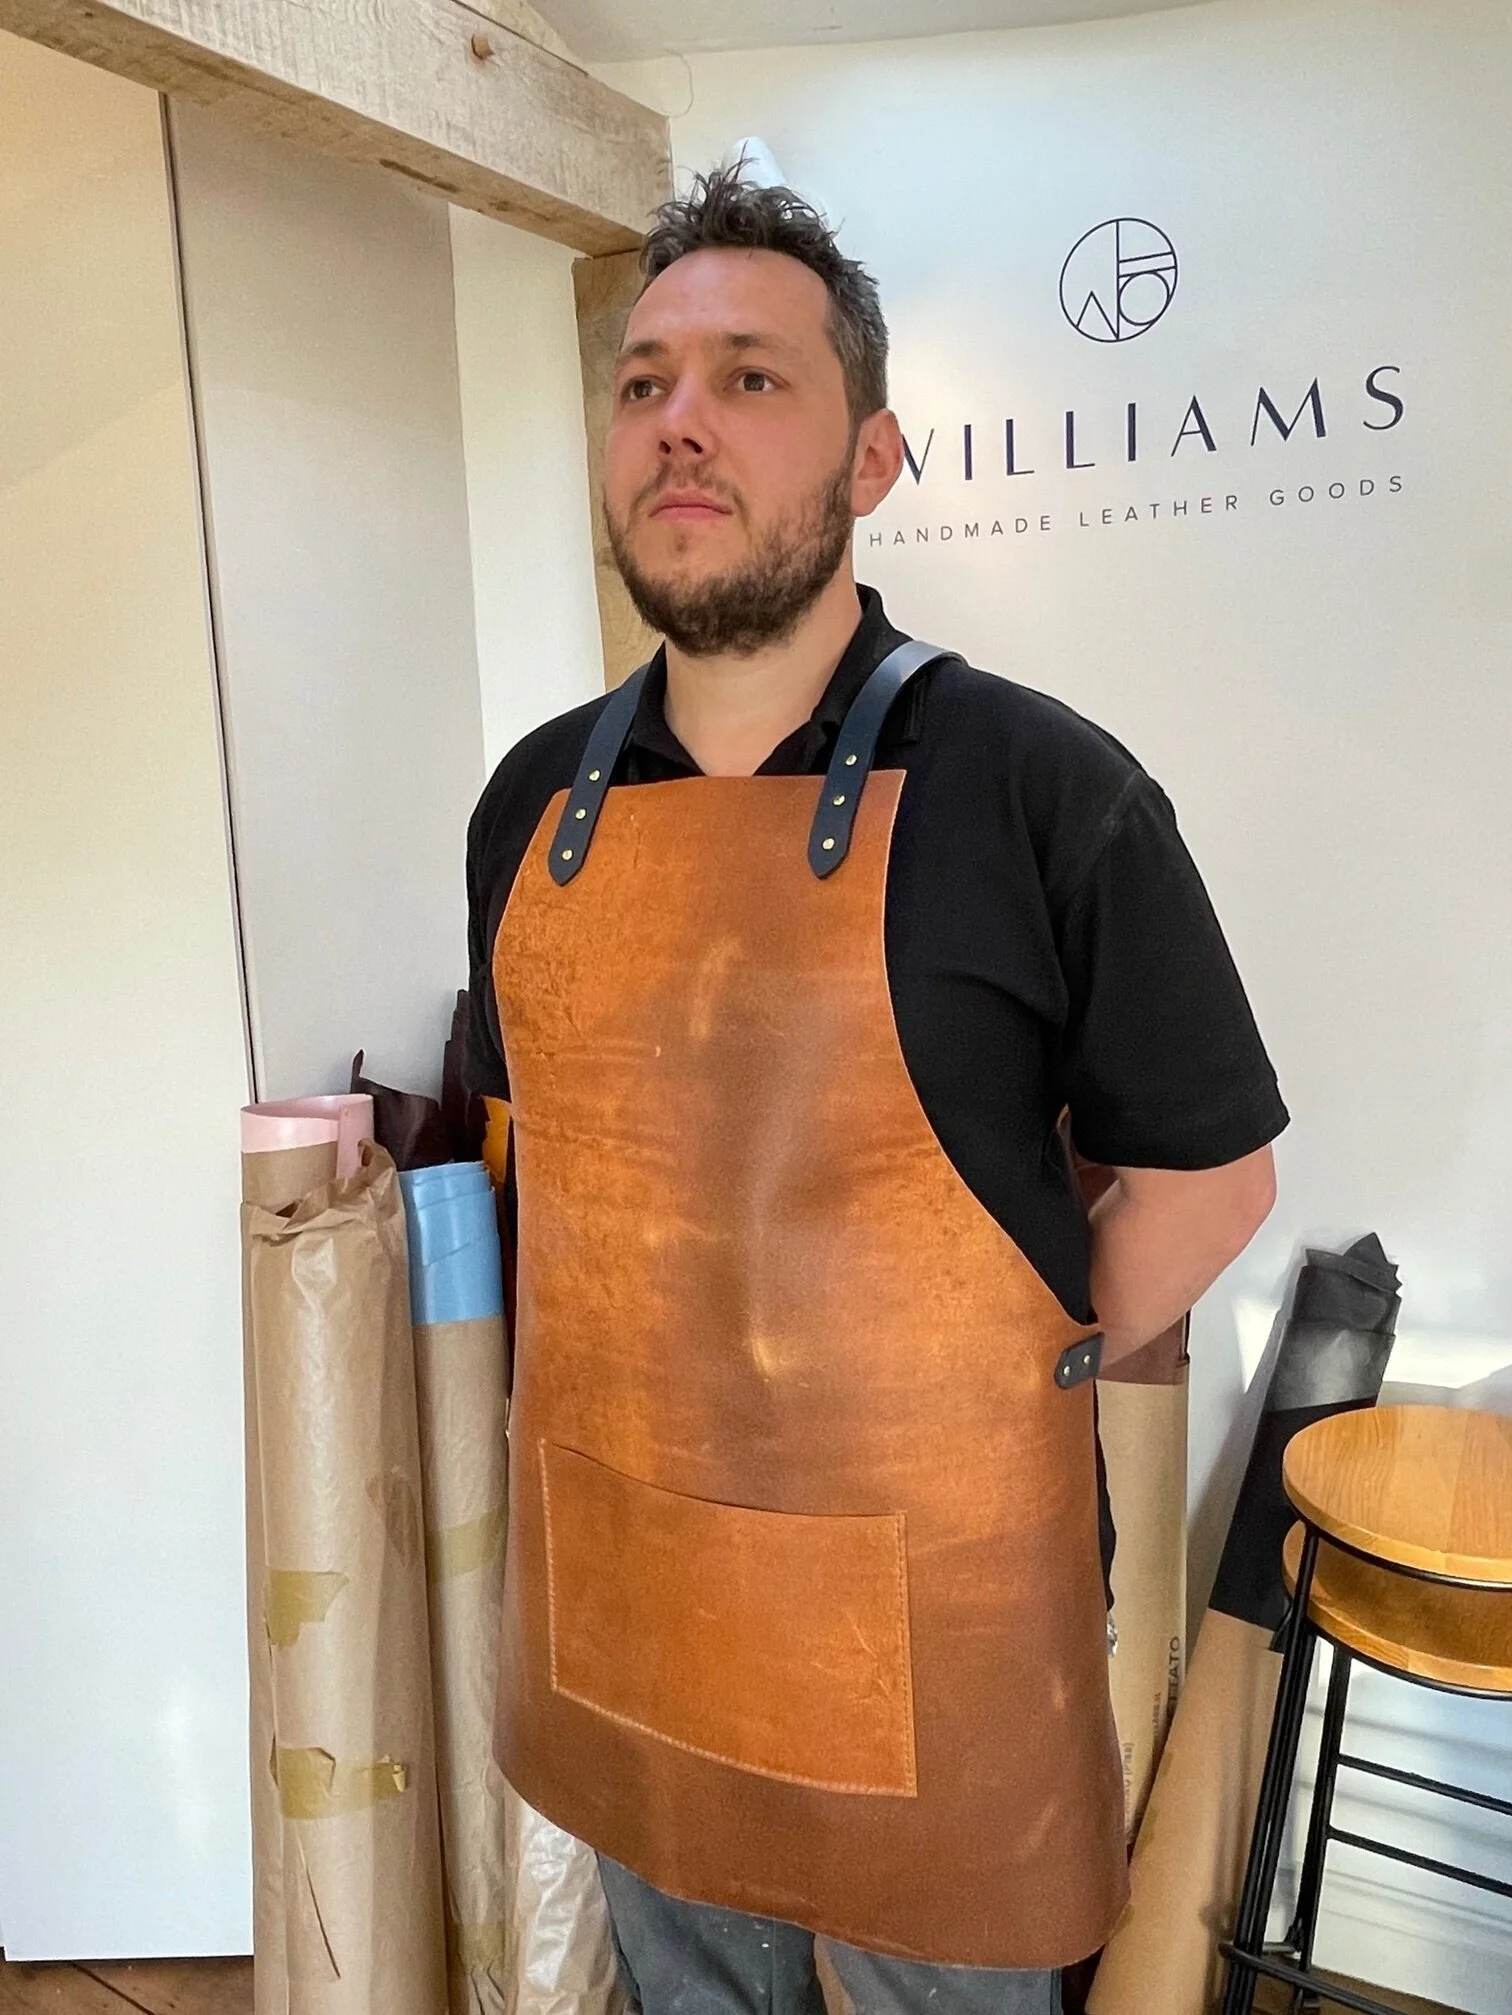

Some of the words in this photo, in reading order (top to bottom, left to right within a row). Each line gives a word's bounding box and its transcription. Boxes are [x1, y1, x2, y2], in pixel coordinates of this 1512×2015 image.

[869, 514, 1051, 548] HANDMADE
[1079, 494, 1238, 528] LEATHER
[1269, 475, 1403, 506] GOODS
